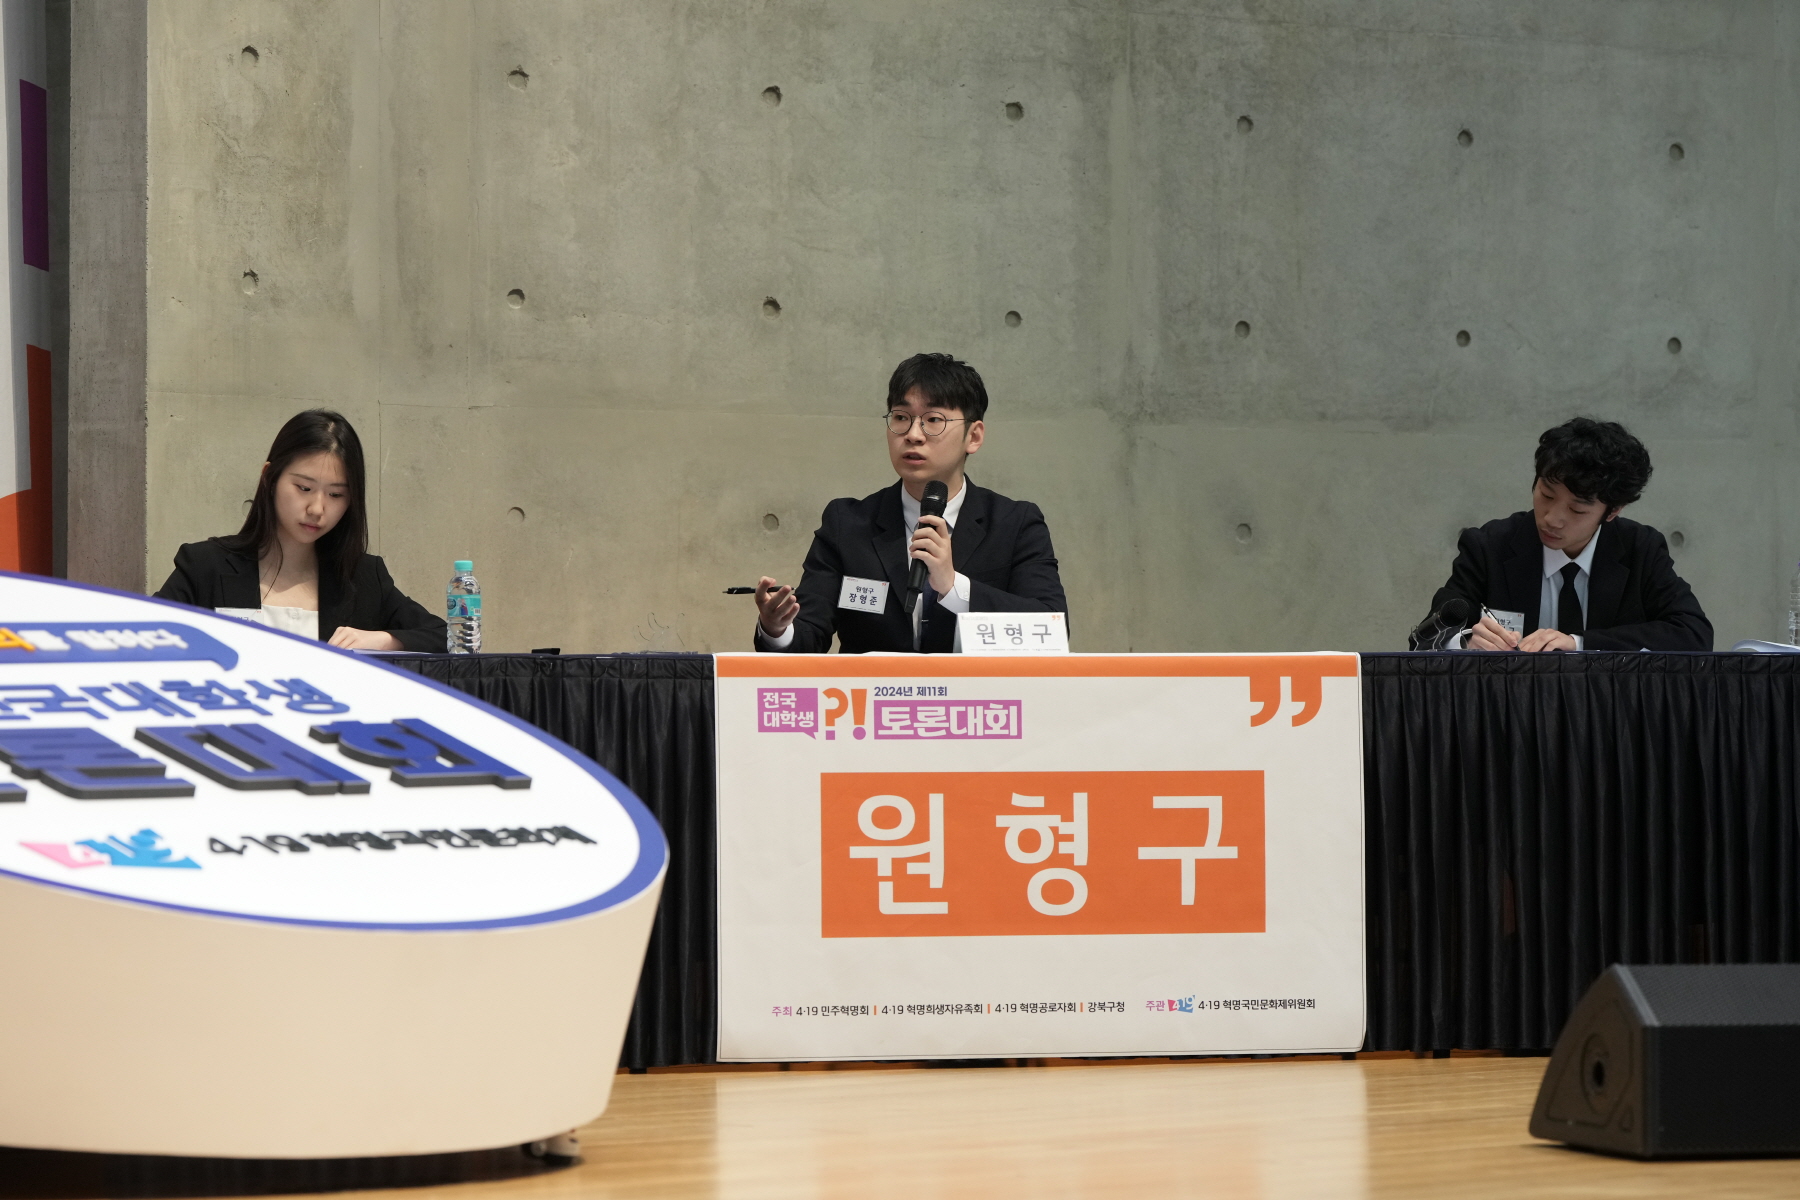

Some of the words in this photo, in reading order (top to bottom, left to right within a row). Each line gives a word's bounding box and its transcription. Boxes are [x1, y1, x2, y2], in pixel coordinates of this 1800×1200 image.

[874, 686, 913, 697] 2024년
[916, 686, 948, 697] 제11회
[0, 679, 350, 720] 국대학생
[763, 692, 797, 708] 전국
[763, 711, 815, 728] 대학생
[878, 702, 1018, 737] 토론대회
[881, 1004, 904, 1015] 4·19
[906, 1003, 983, 1015] 혁명희생자유족회
[995, 1003, 1017, 1013] 4·19
[1019, 1002, 1077, 1013] 혁명공로자회
[1087, 1002, 1125, 1012] 강북구청
[1145, 1000, 1165, 1011] 주관
[1198, 1000, 1221, 1010] 4·19
[1222, 998, 1316, 1010] 혁명국민문화제위원회
[772, 1006, 793, 1017] 주최
[796, 1006, 818, 1016] 4·19
[821, 1005, 869, 1016] 민주혁명회
